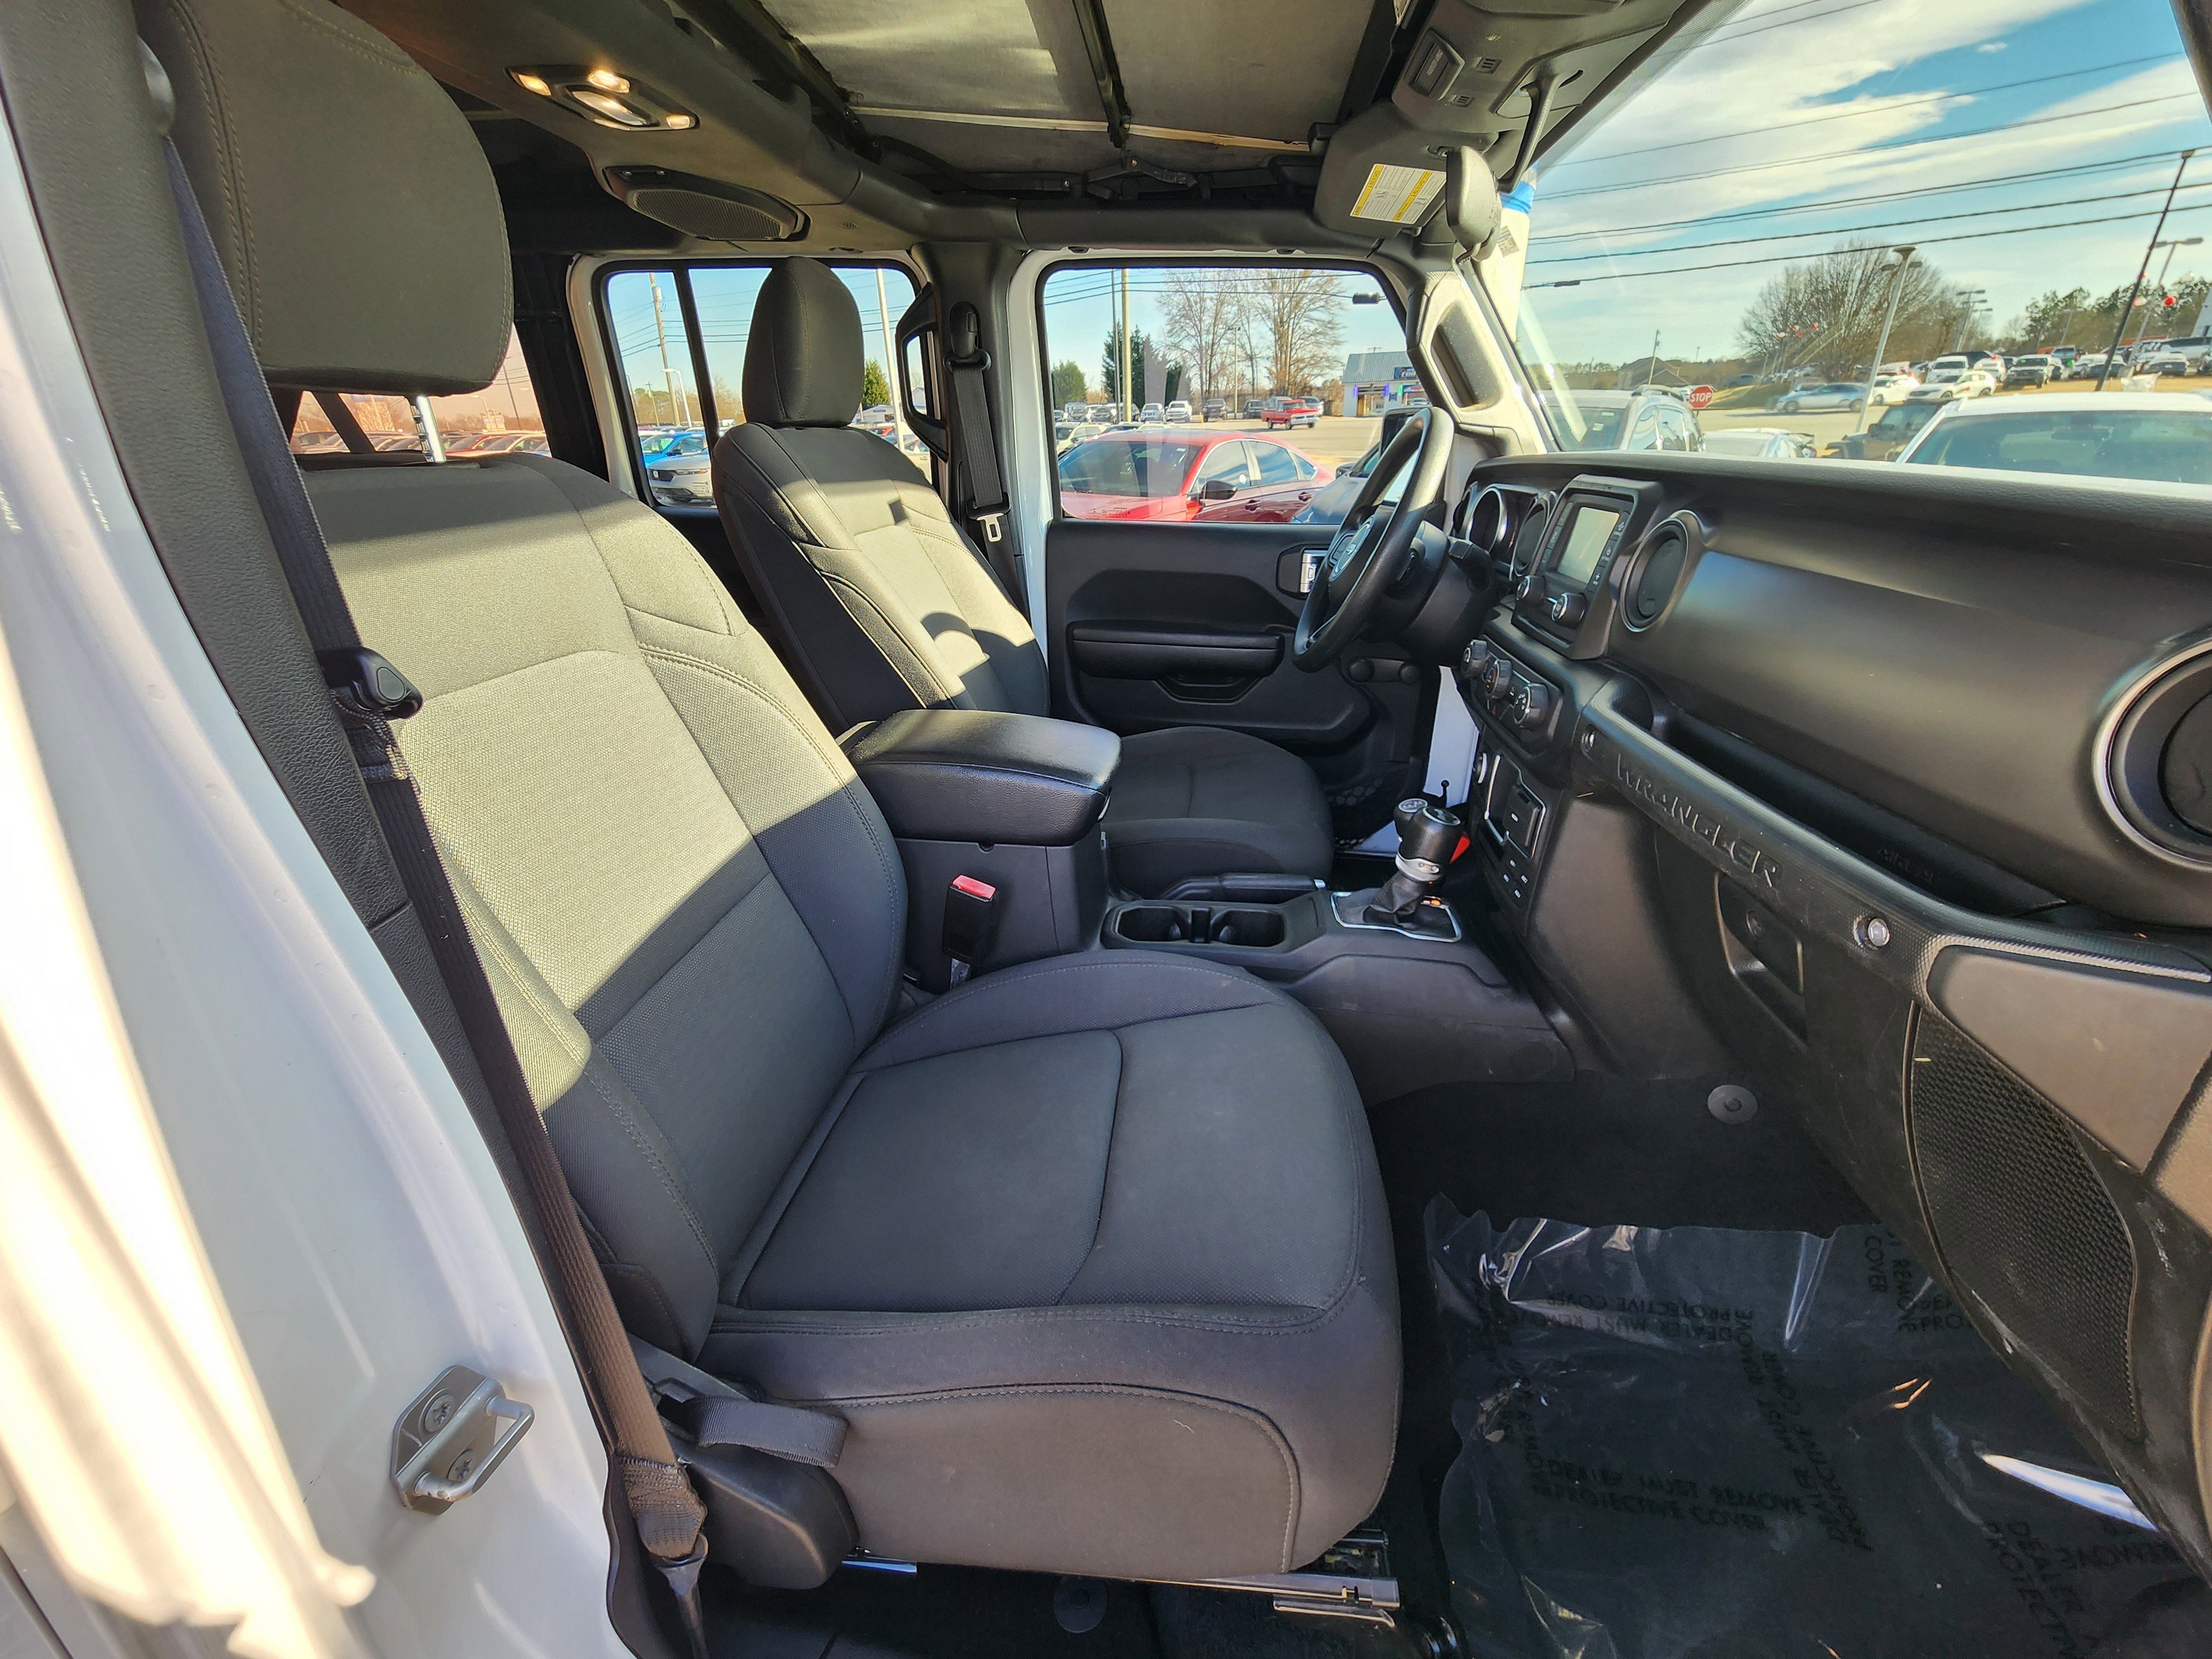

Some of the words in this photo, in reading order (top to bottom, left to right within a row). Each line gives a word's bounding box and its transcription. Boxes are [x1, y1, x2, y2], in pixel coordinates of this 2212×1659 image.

[1690, 392, 1712, 403] STOP
[1616, 753, 1781, 889] WRANGLER
[1864, 1235, 1888, 1293] COVER
